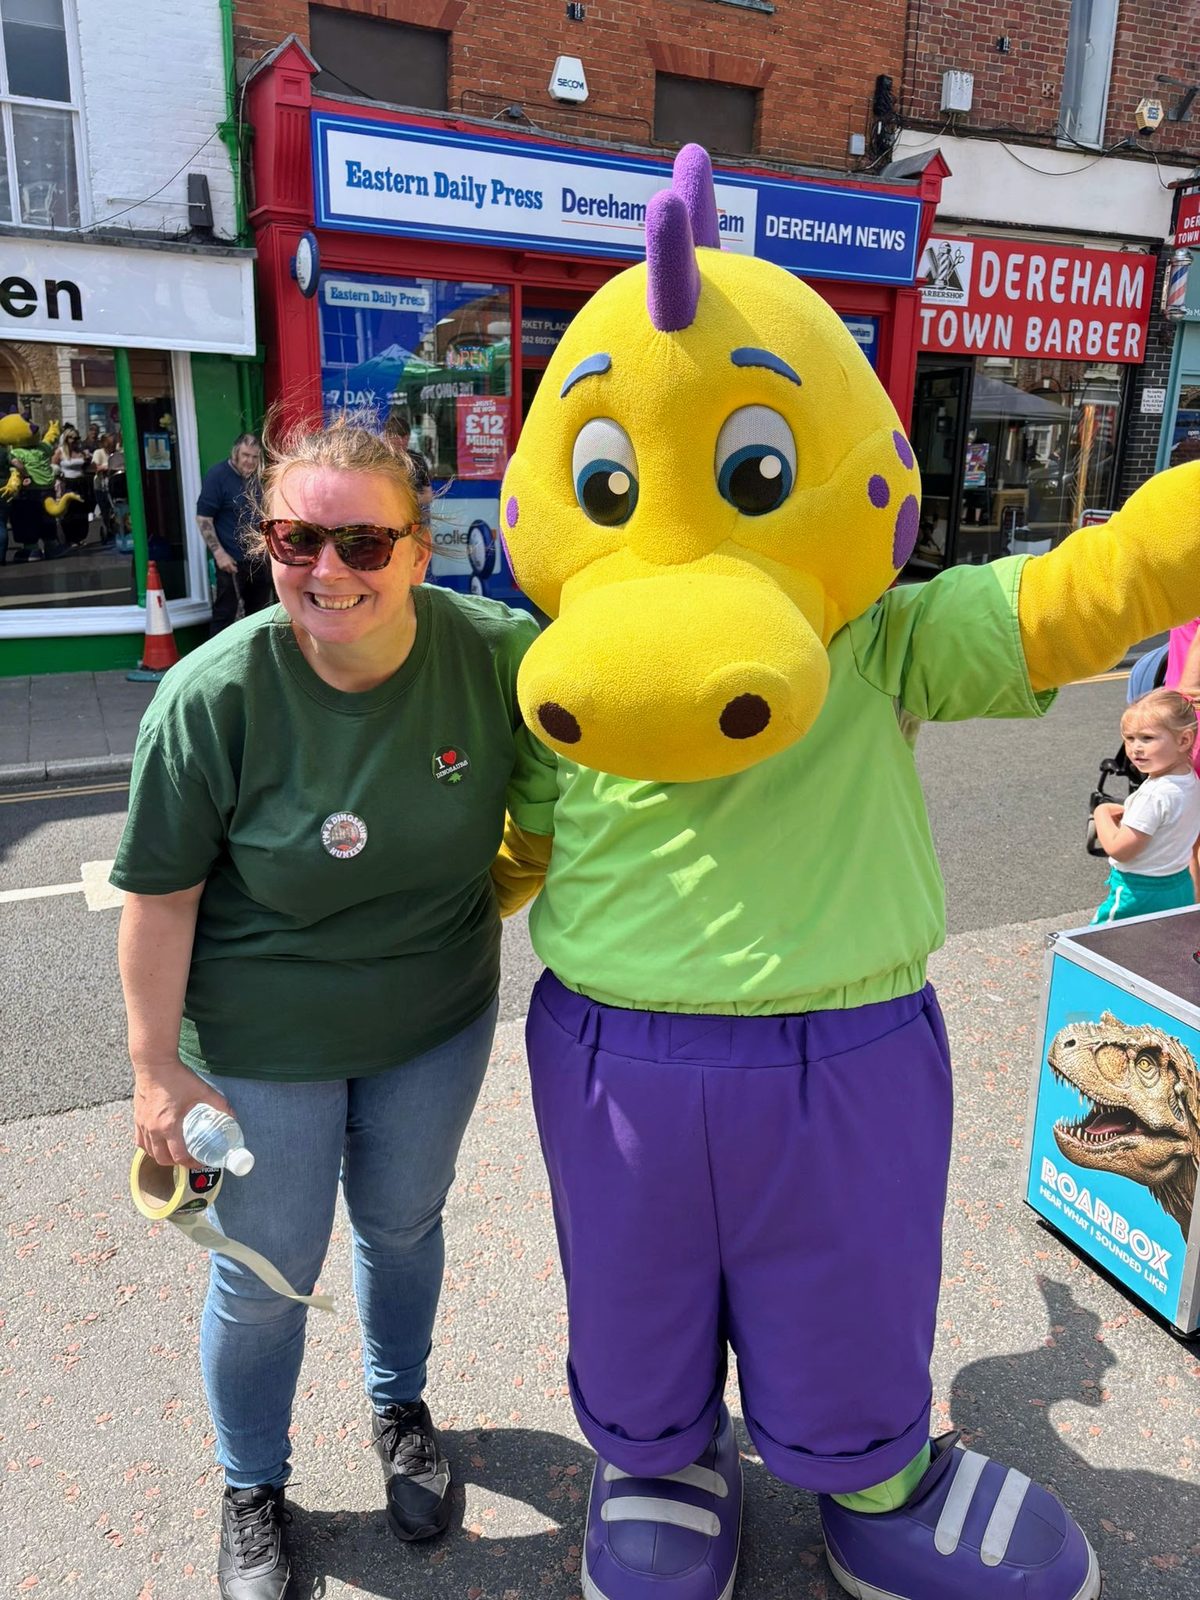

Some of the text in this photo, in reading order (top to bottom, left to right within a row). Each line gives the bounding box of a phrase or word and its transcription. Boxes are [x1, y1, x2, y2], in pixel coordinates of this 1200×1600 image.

[557, 78, 585, 90] SECOM
[345, 160, 543, 210] Eastern Daily Press
[562, 187, 646, 222] Dereham
[719, 213, 744, 233] am
[765, 215, 906, 251] DEREHAM NEWS
[978, 250, 1145, 309] DEREHAM
[0, 276, 83, 321] en
[330, 287, 425, 307] Eastern Daily Press
[544, 321, 569, 331] PLAC
[920, 308, 1142, 358] TOWN BARBER
[330, 390, 340, 404] 7
[344, 390, 376, 405] DAY
[466, 414, 504, 435] £12
[466, 434, 504, 446] Million
[470, 447, 499, 455] Jackpot
[436, 756, 445, 770] I
[436, 760, 468, 779] DINOSAURS
[325, 823, 334, 831] A
[331, 813, 367, 839] DINOSAUR
[329, 843, 364, 859] HUNTER
[1040, 1156, 1172, 1280] ROARBOX
[1040, 1185, 1168, 1295] HEAR WHAT I SOUNDED LIKE!
